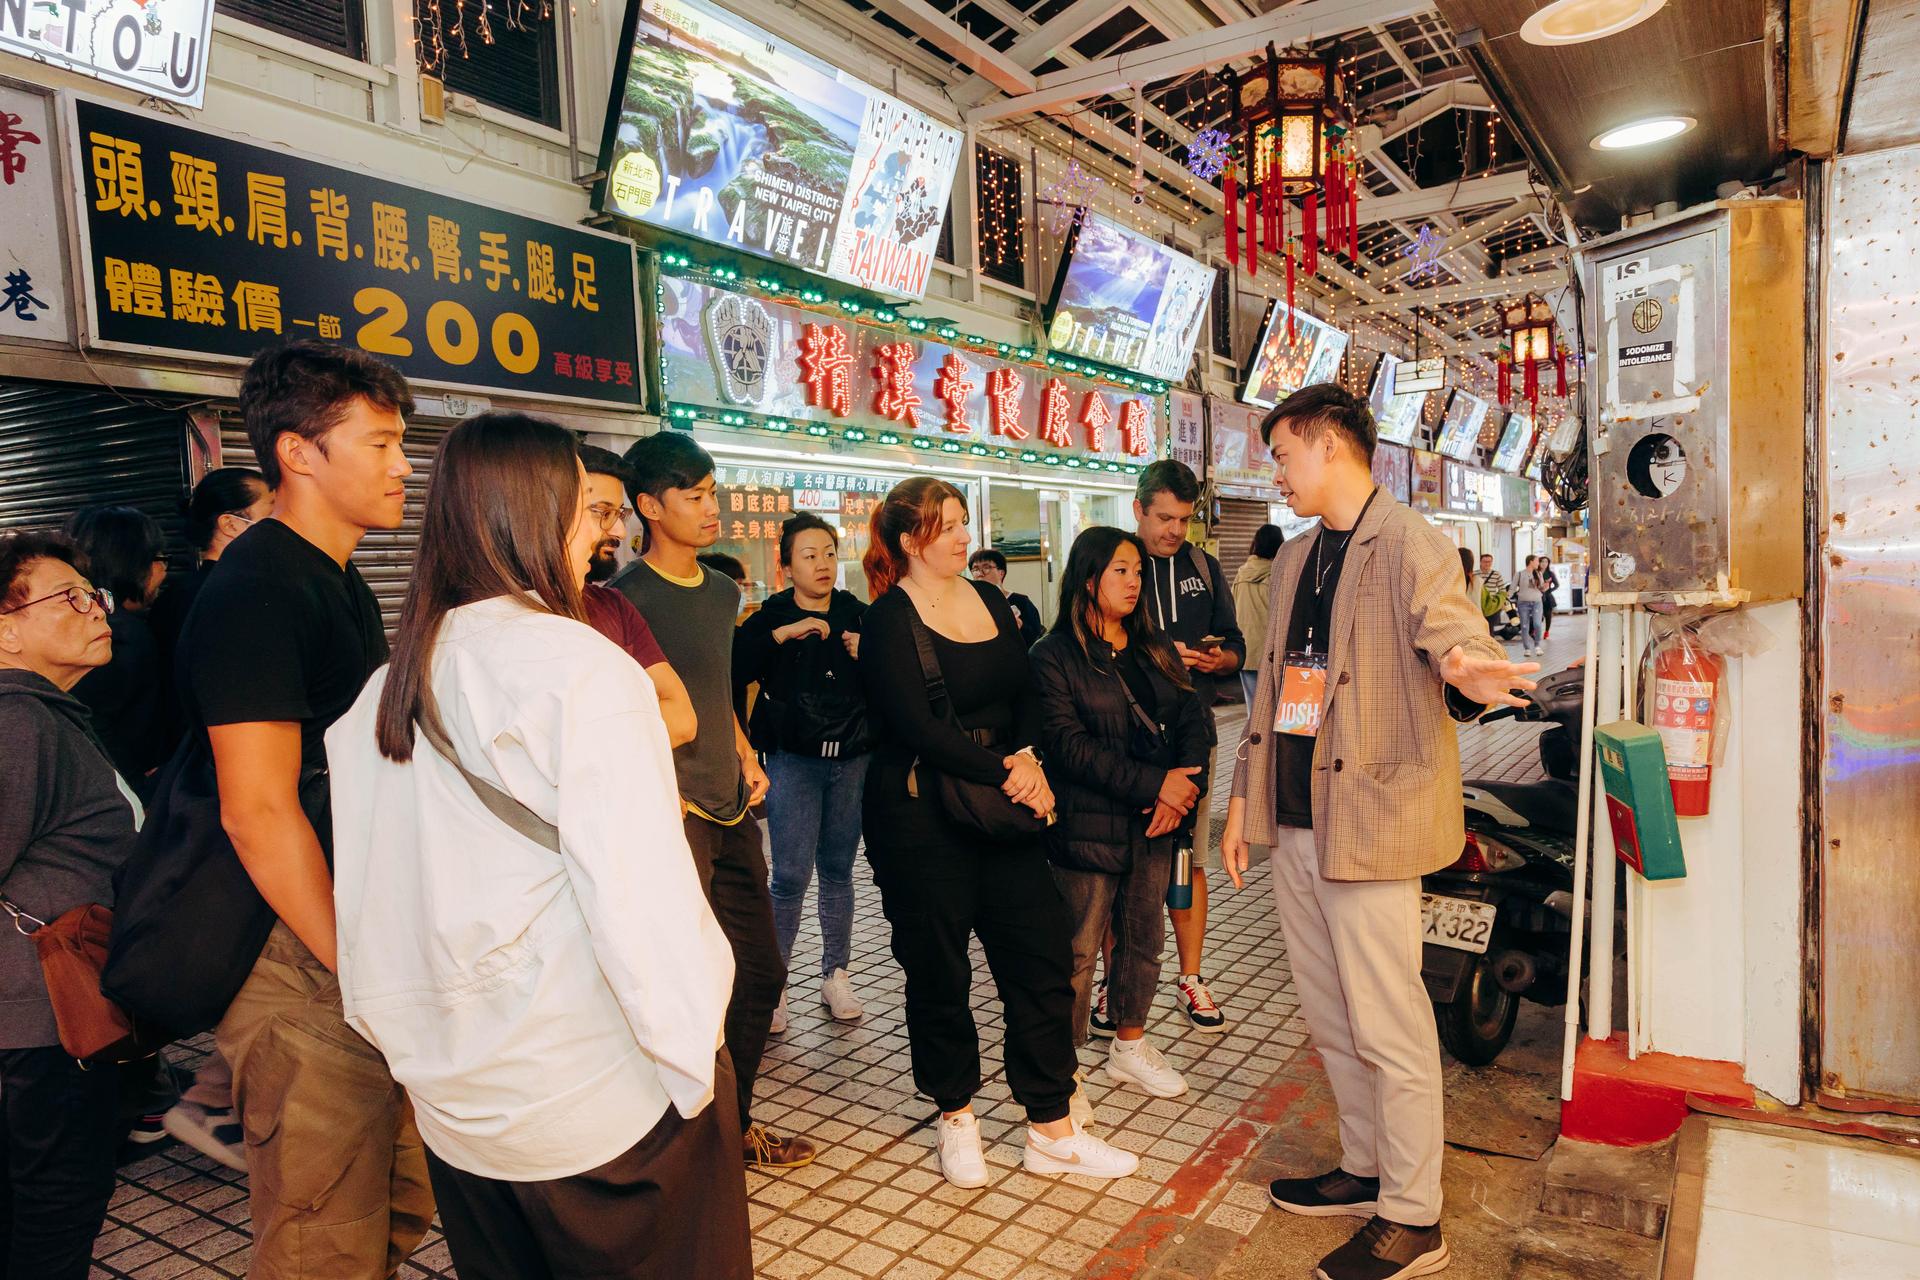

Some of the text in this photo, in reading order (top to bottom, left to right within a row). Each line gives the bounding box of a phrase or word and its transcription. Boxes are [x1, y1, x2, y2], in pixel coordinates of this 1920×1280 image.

[623, 160, 653, 180] 新北市
[754, 169, 794, 194] SHIMEN
[615, 181, 653, 208] 石門區
[754, 186, 836, 225] NEW TAIPEI CITY
[849, 229, 930, 295] TAIWAN
[104, 256, 541, 375] 體驗價 一節 200
[1620, 353, 1671, 367] INTOLERANCE
[1626, 344, 1665, 356] SODOMIZE
[552, 351, 634, 387] 高級享受
[730, 492, 790, 513] 腳底按摩
[799, 489, 821, 507] 400
[1180, 576, 1206, 595] NIKE
[1278, 702, 1319, 726] JOSH
